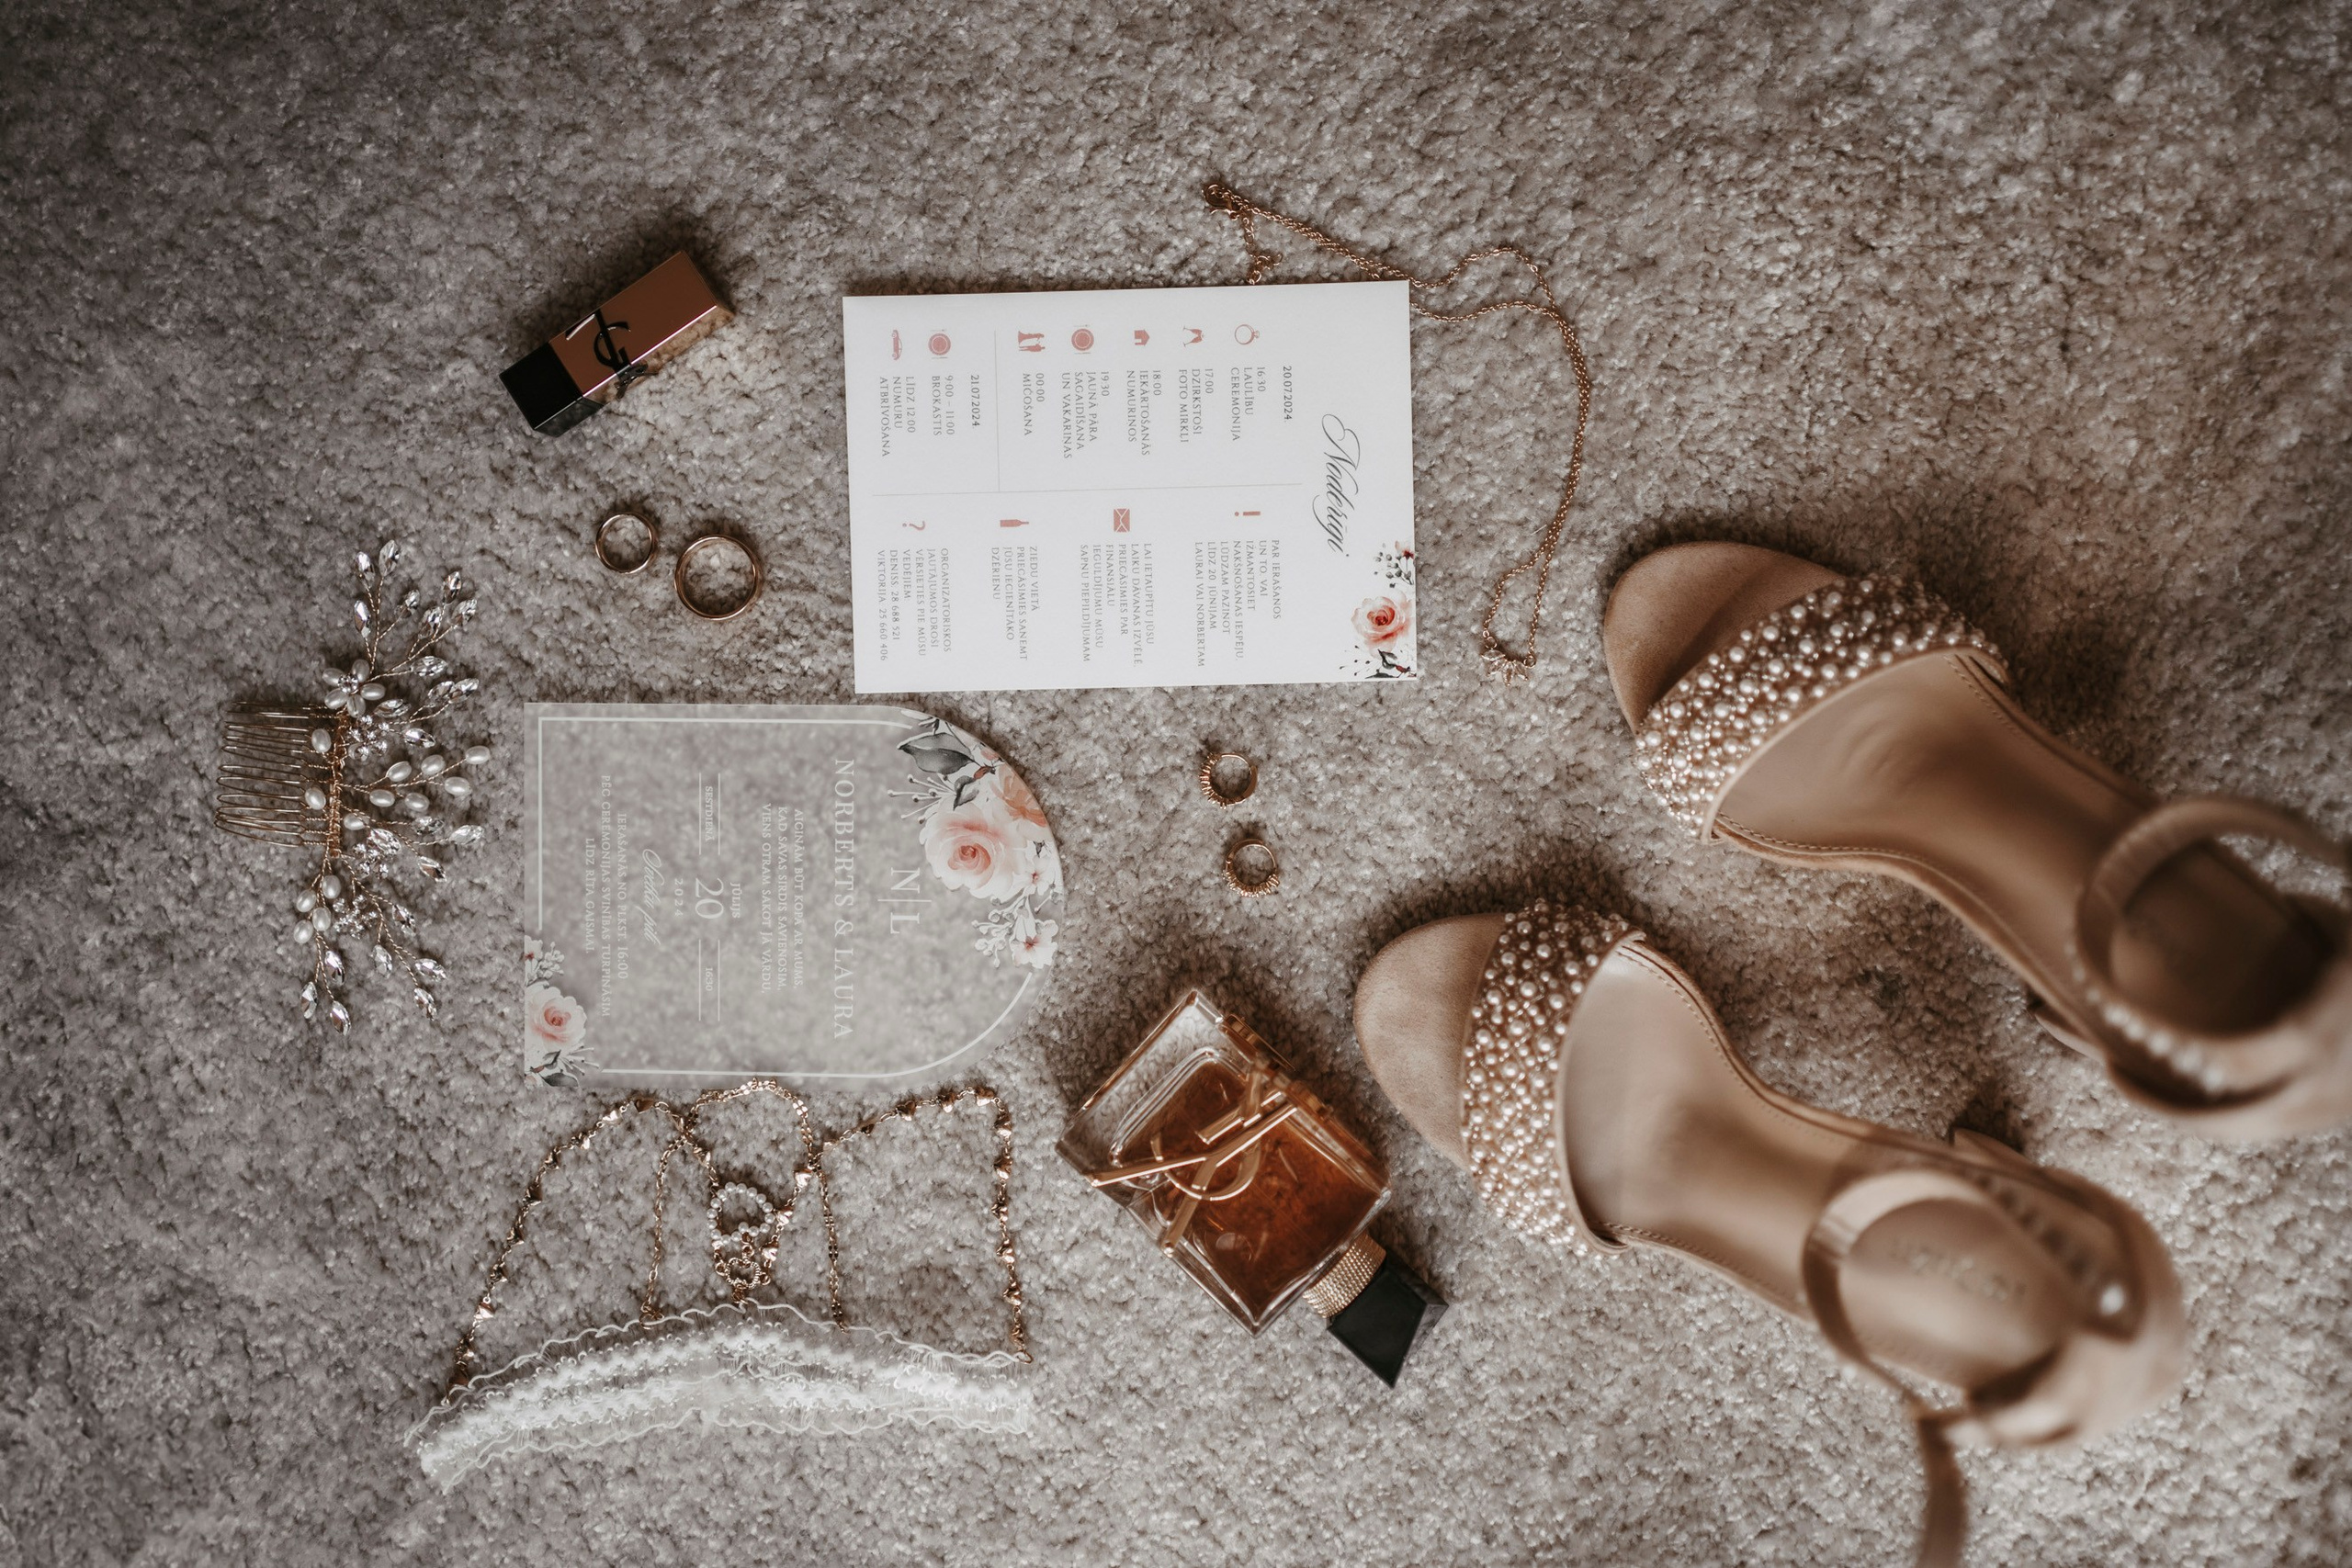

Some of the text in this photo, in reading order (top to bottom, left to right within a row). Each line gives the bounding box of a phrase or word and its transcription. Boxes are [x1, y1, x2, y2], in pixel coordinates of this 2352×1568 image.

[944, 375, 954, 398] 9:00
[1035, 373, 1045, 402] 00:00
[1062, 372, 1070, 389] UN
[1101, 371, 1110, 397] 19:30
[1153, 370, 1161, 396] 18:00
[1179, 369, 1188, 400] FOTO
[1204, 368, 1214, 394] 17:00
[1257, 367, 1266, 392] 16:30
[893, 376, 902, 429] NUMURU
[932, 376, 942, 436] BROKASTIS
[1229, 367, 1241, 441] CEREMONIJA
[907, 407, 916, 434] 12:00
[945, 411, 955, 435] 11:00
[1312, 413, 1361, 558] Noderīgi
[1030, 546, 1038, 578] ZIEDU
[1131, 544, 1141, 574] LAIKU
[1144, 543, 1152, 559] LAI
[1195, 542, 1204, 580] LAURAI
[1259, 540, 1267, 556] UN
[1272, 539, 1280, 558] PAR
[891, 591, 899, 602] 28
[941, 547, 951, 652] ORGANIZATORISKOS
[1260, 579, 1268, 596] VAI
[879, 608, 887, 619] 25
[891, 605, 899, 623] 688
[917, 608, 925, 623] PIE
[1120, 616, 1128, 636] PAR
[879, 622, 888, 640] 660
[892, 626, 900, 640] 521
[1196, 604, 1205, 667] NORBERTAM
[880, 643, 888, 660] 406
[762, 804, 771, 838] VIENS
[778, 807, 787, 831] KAD
[600, 801, 611, 882] CEREMONIJAS
[778, 836, 787, 870] SAVAS
[762, 842, 771, 885] OTRAM
[617, 882, 627, 900] NO
[674, 878, 684, 917] 2024
[695, 877, 724, 919] 20
[778, 874, 787, 911] SIRDIS
[833, 760, 854, 1039] NORBERTS & LAURA
[889, 866, 921, 935] N L
[762, 889, 771, 927] SAKOT
[585, 900, 595, 954] GAISMAI.
[617, 905, 627, 942] PLKST.
[794, 930, 802, 945] AR
[617, 946, 628, 979] 16:00
[705, 967, 713, 991] 16:30
